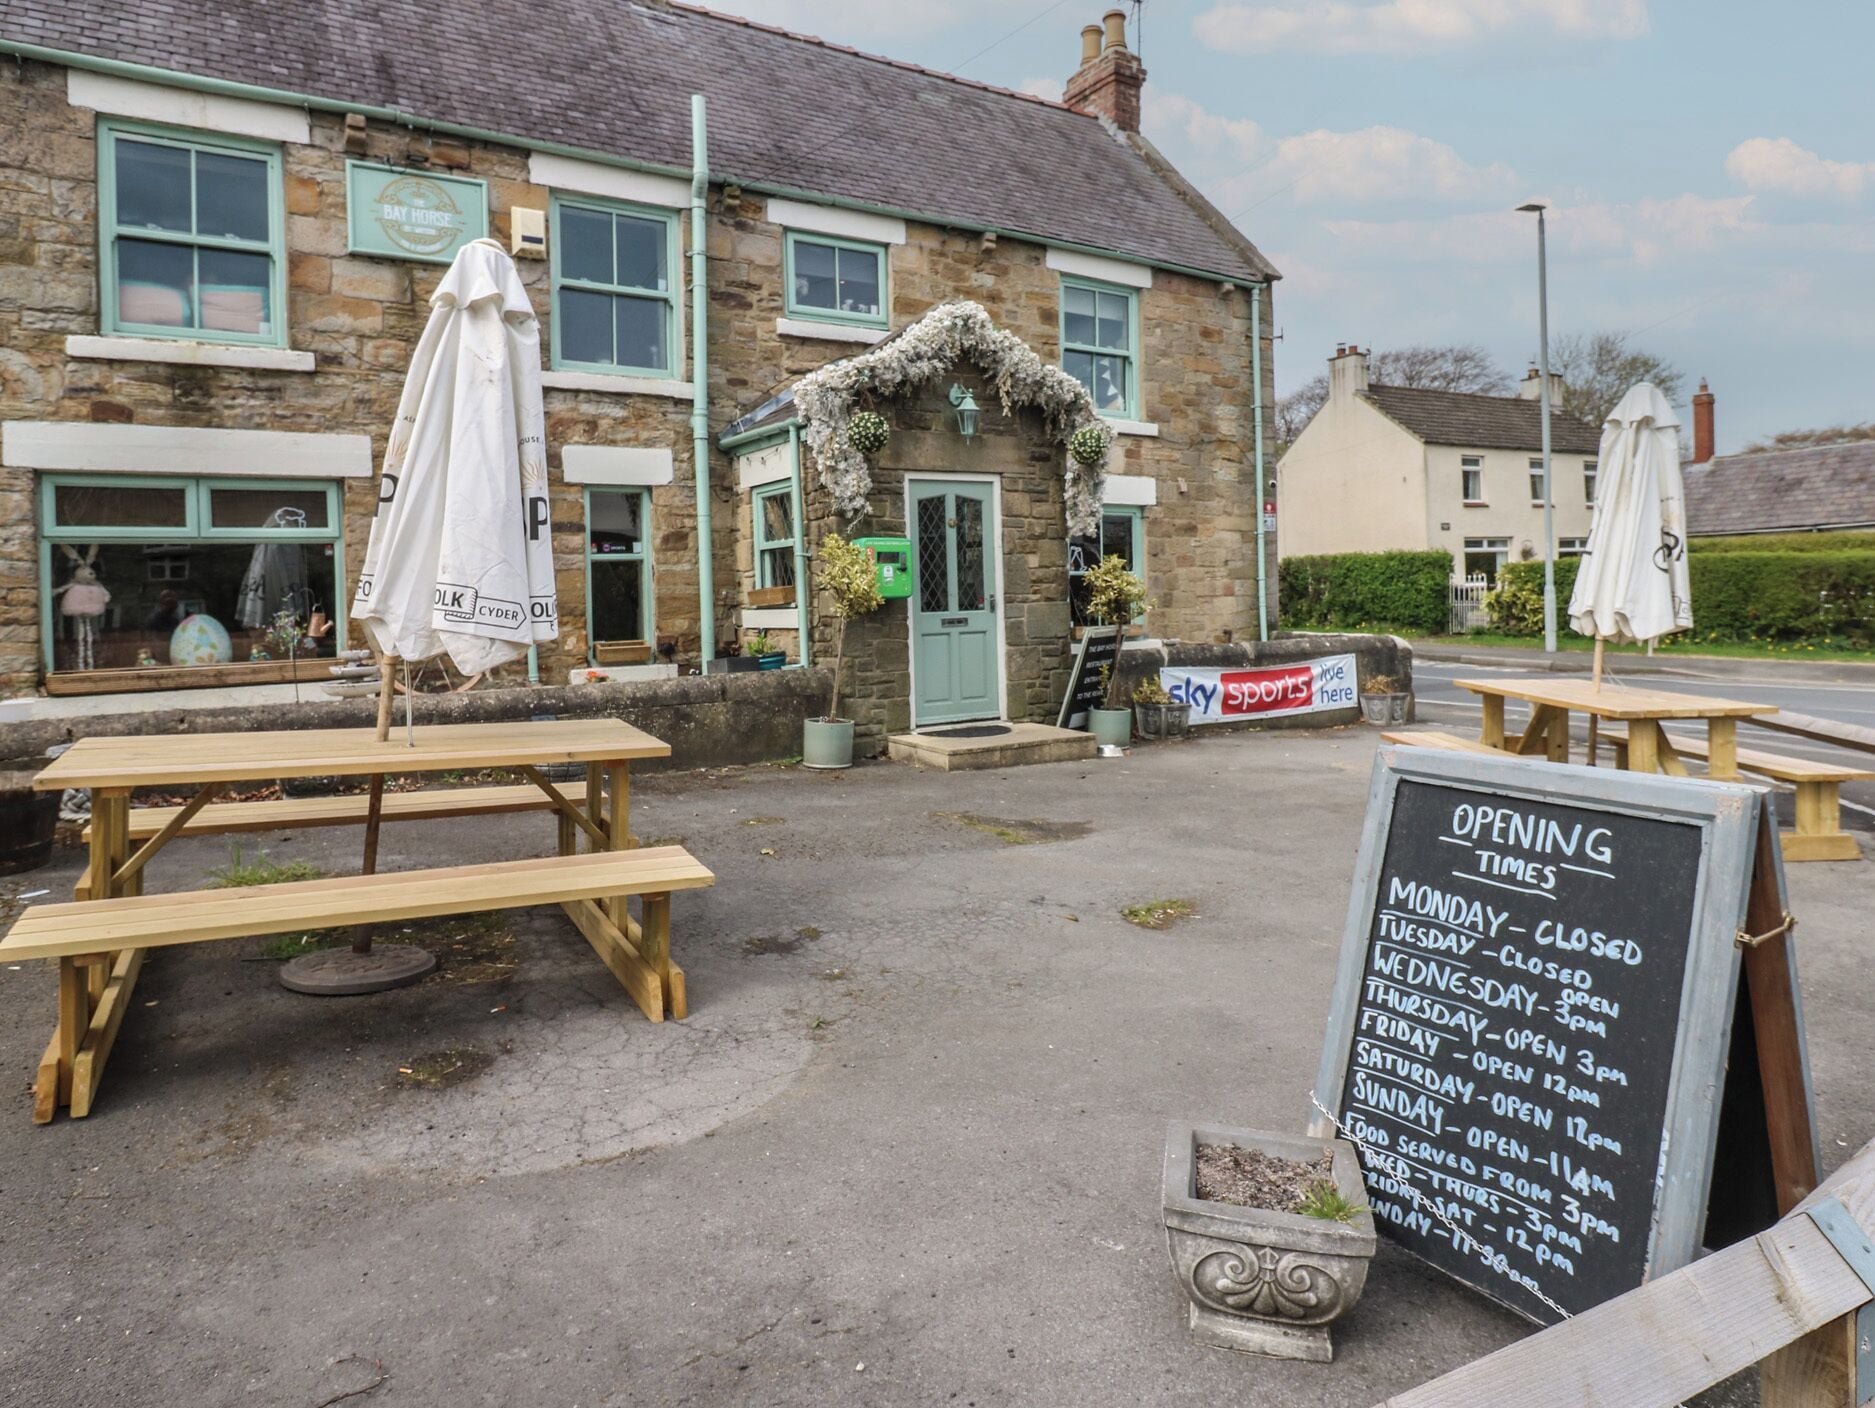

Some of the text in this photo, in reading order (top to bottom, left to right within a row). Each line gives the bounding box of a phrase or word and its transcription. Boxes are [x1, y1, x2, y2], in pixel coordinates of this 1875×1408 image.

[383, 204, 454, 228] BAY HORSE
[478, 604, 519, 622] CYDER
[1169, 663, 1345, 715] sky sports live
[1321, 685, 1353, 704] here
[1452, 804, 1613, 864] OPENING
[1475, 850, 1557, 889] TIMES
[1379, 914, 1476, 955] TUESDAY
[1499, 945, 1593, 990] CLOSED
[1388, 876, 1509, 937] MONDAY
[1534, 920, 1643, 966] CLOSED
[1373, 944, 1538, 1016] WEDNESDAY
[1561, 988, 1620, 1019] OPEN
[1360, 1011, 1440, 1056] FRIDAY
[1472, 1052, 1534, 1085] OPEN
[1366, 980, 1489, 1046] THURSDAY
[1504, 1028, 1567, 1065] OPEN
[1353, 1071, 1444, 1135] SUNDAY
[1466, 1126, 1530, 1164] OPEN
[1356, 1041, 1475, 1104] SATURDAY
[1490, 1092, 1553, 1130] OPEN
[1345, 1111, 1390, 1146] FOOD
[1396, 1135, 1477, 1176] SERVED
[1482, 1165, 1553, 1204] FROM
[1428, 1170, 1500, 1214] THURS
